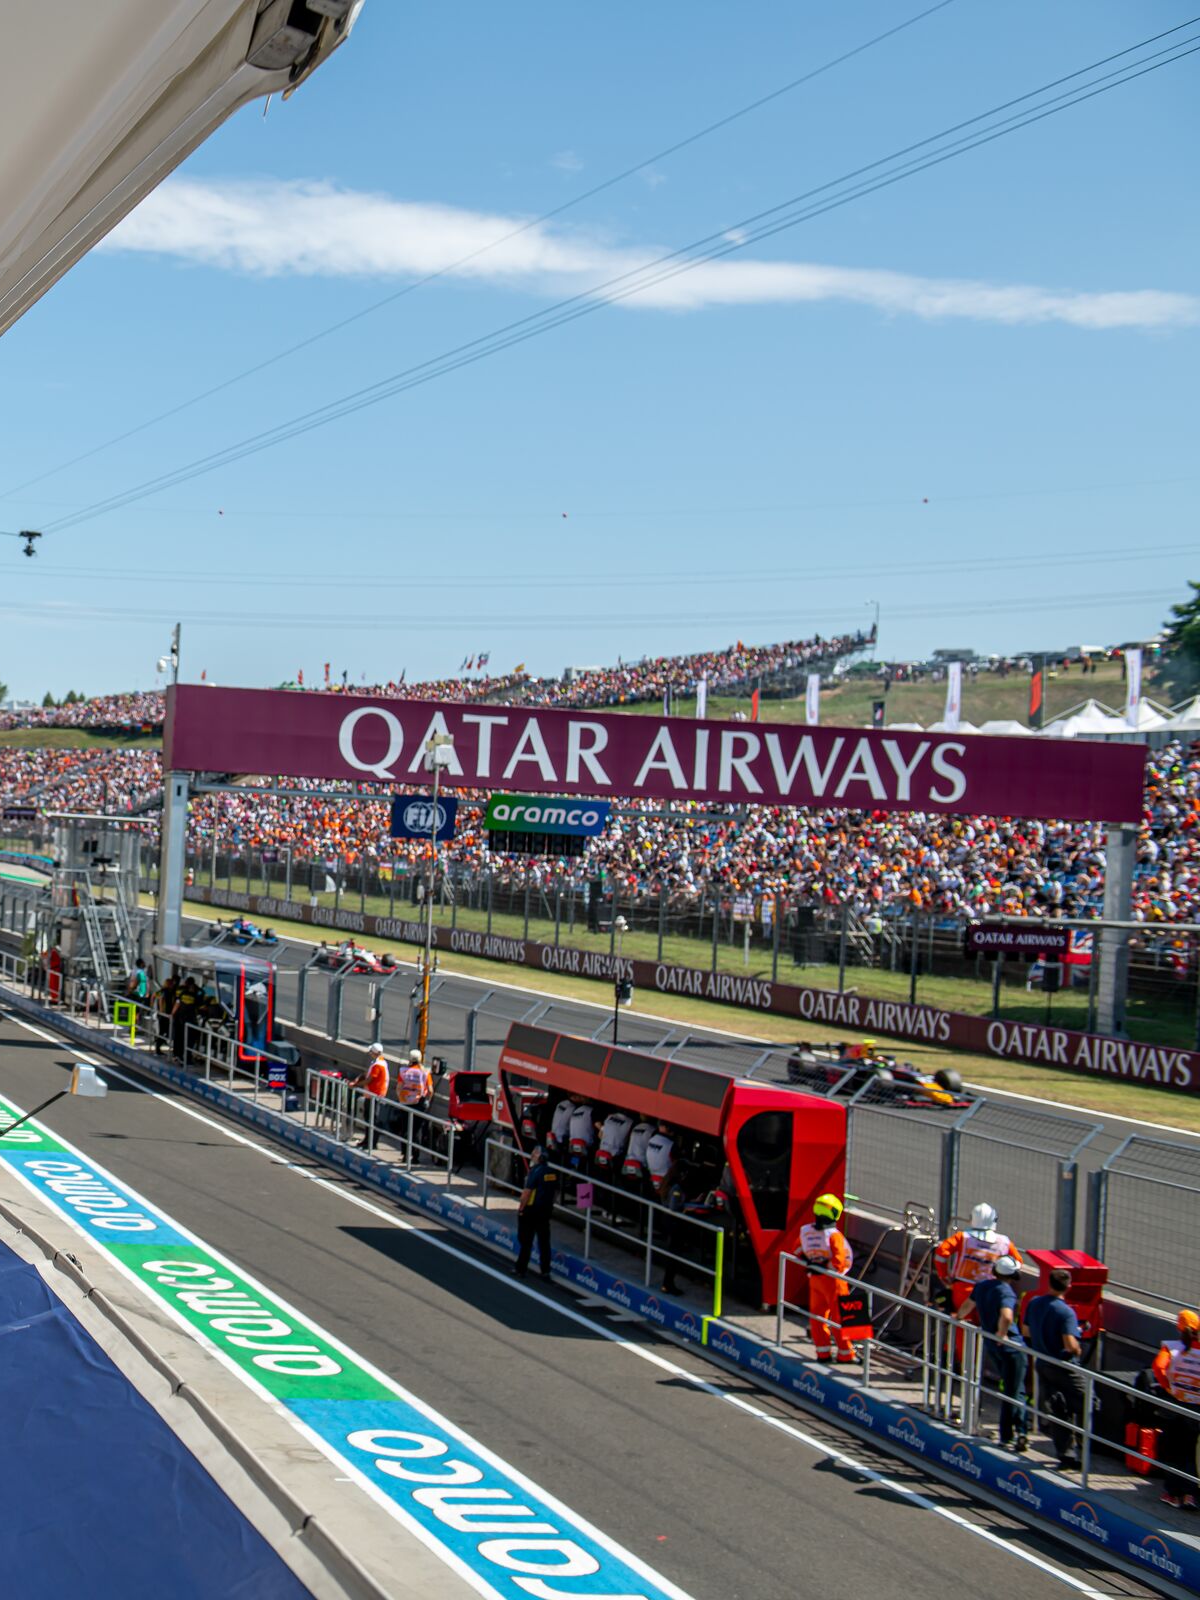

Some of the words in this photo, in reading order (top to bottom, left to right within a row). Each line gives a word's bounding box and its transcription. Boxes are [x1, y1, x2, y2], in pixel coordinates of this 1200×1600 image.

[338, 706, 612, 786] QATAR
[633, 725, 967, 804] AIRWAYS
[492, 804, 599, 827] aramco
[375, 918, 401, 938] QATAR
[973, 931, 1013, 945] QATAR
[1016, 933, 1066, 947] AIRWAYS
[450, 931, 482, 955] QATAR
[483, 936, 526, 963] AIRWAYS
[542, 946, 580, 970] QATAR
[581, 952, 634, 980] AIRWAYS
[655, 964, 703, 994] QATAR
[705, 972, 772, 1008] AIRWAYS
[799, 989, 860, 1025] QATAR
[864, 1000, 951, 1041] AIRWAYS
[986, 1021, 1073, 1064] QATAR
[1074, 1037, 1192, 1086] AIRWAYS
[23, 1160, 158, 1232] aramco
[141, 1260, 343, 1376] aramco
[711, 1337, 741, 1362] workday
[750, 1357, 782, 1382] workday
[792, 1378, 826, 1404] workday
[838, 1401, 874, 1428] workday
[887, 1424, 926, 1452] workday
[940, 1449, 982, 1480] workday
[996, 1477, 1042, 1511] workday
[346, 1429, 649, 1600] ramco
[1059, 1508, 1110, 1544] workday
[1128, 1541, 1185, 1579] workday
